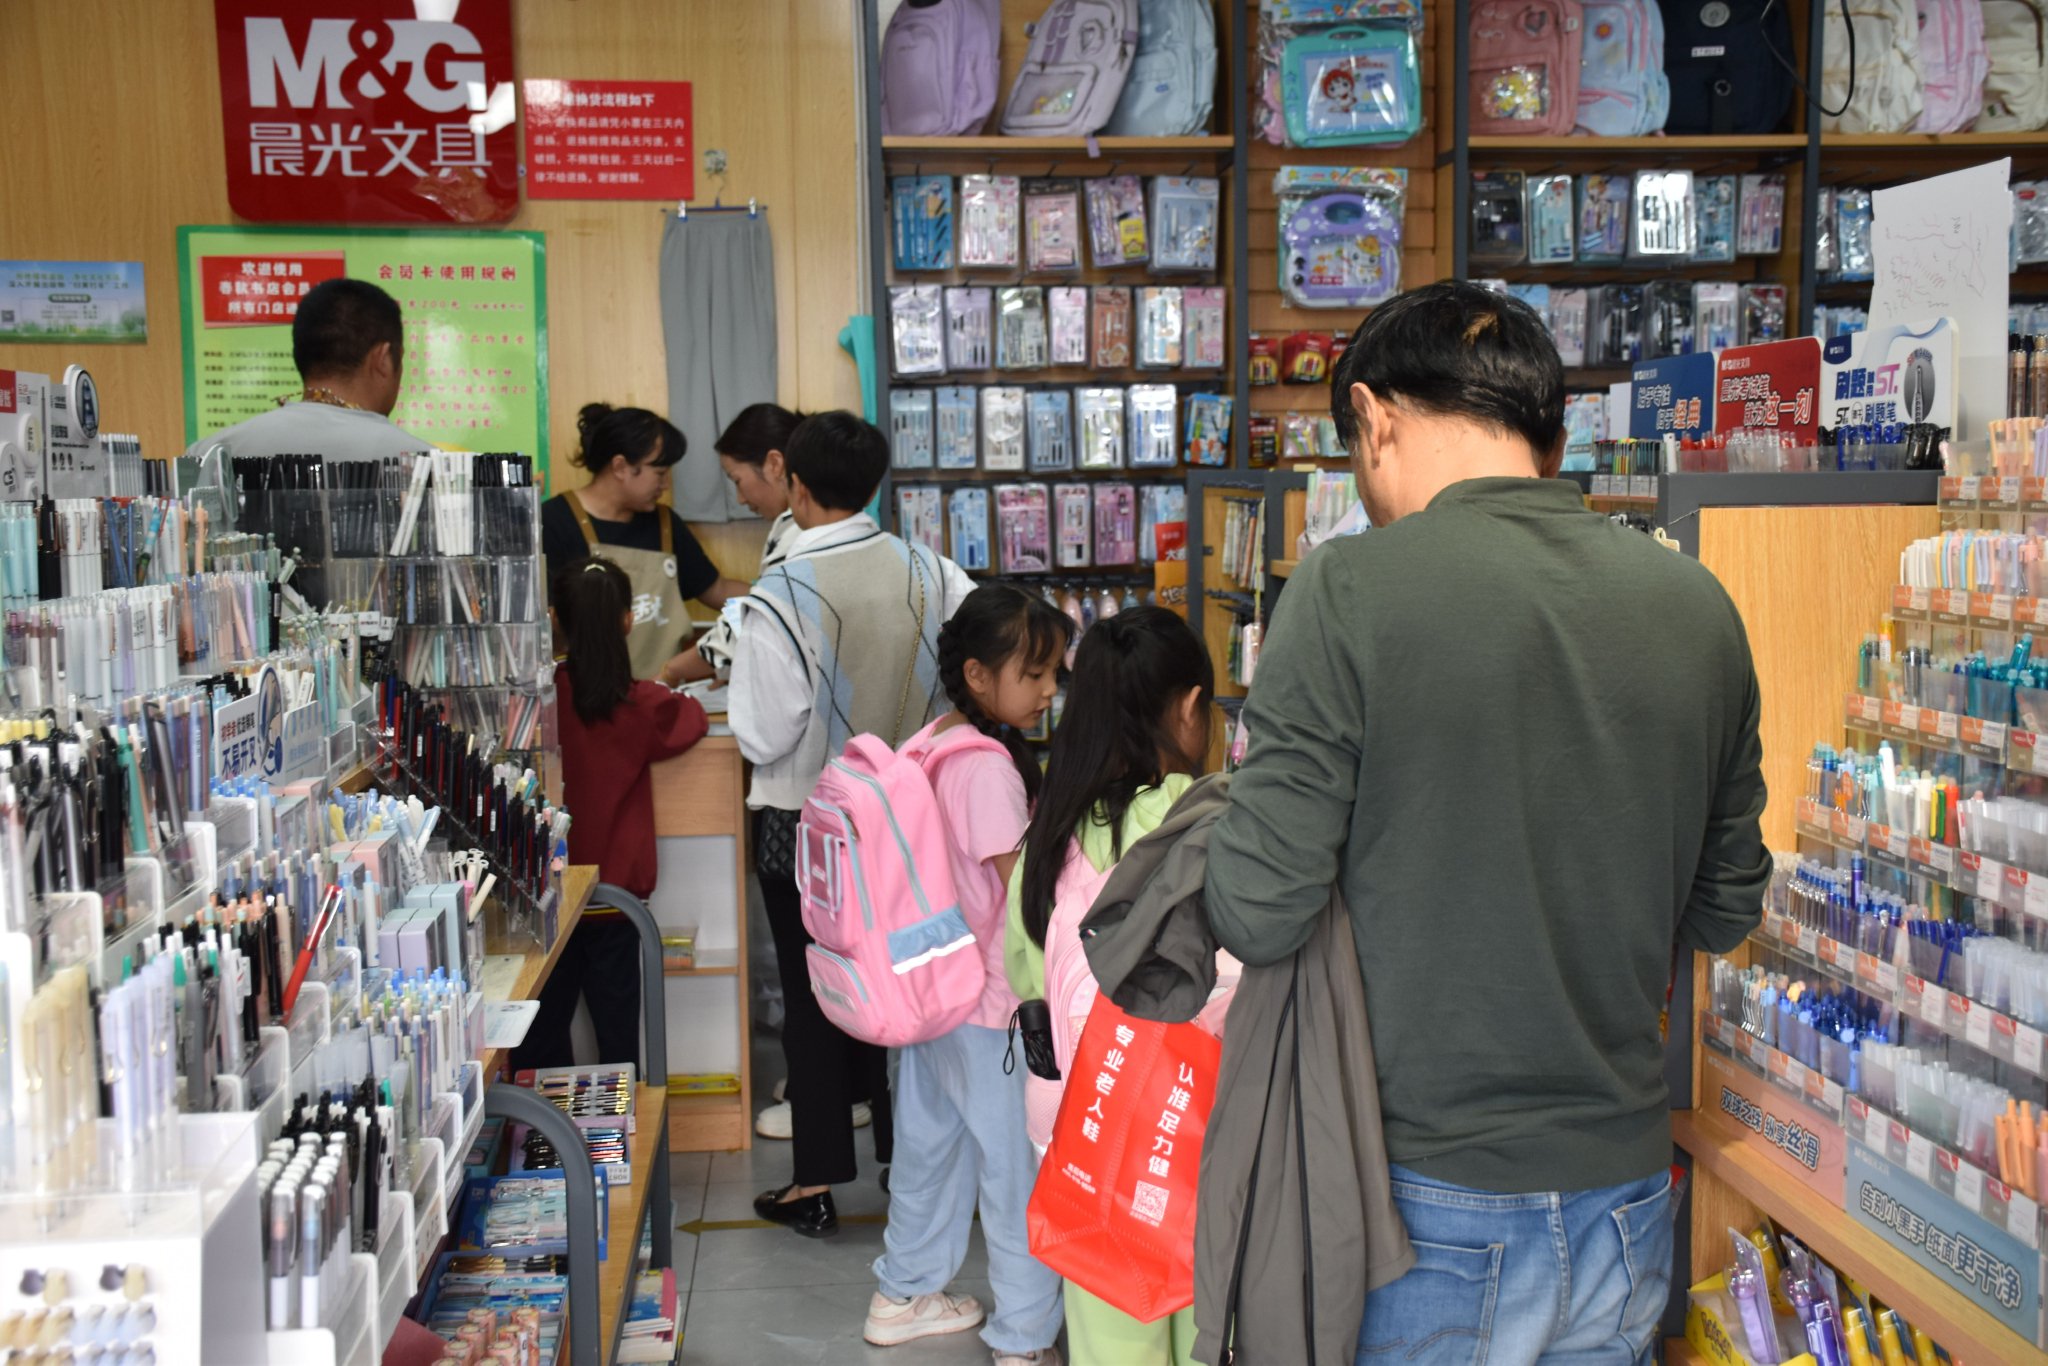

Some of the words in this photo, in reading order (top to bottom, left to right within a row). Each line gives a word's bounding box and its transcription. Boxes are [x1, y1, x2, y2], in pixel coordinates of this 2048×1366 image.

[244, 16, 488, 113] M&G
[249, 121, 493, 178] 晨光文具
[241, 261, 303, 277] 欢迎使用
[379, 264, 517, 281] 会员卡使用规则
[1720, 373, 1771, 403] 晨光考试笔
[1743, 387, 1814, 427] 就为这一刻
[1082, 1024, 1136, 1144] 专业老人鞋
[1148, 1061, 1196, 1179] 认准足力健
[1763, 1112, 1820, 1172] 纵享丝滑
[1860, 1180, 1927, 1245] 告别小黑手
[1925, 1221, 2022, 1309] 纸面更干净
